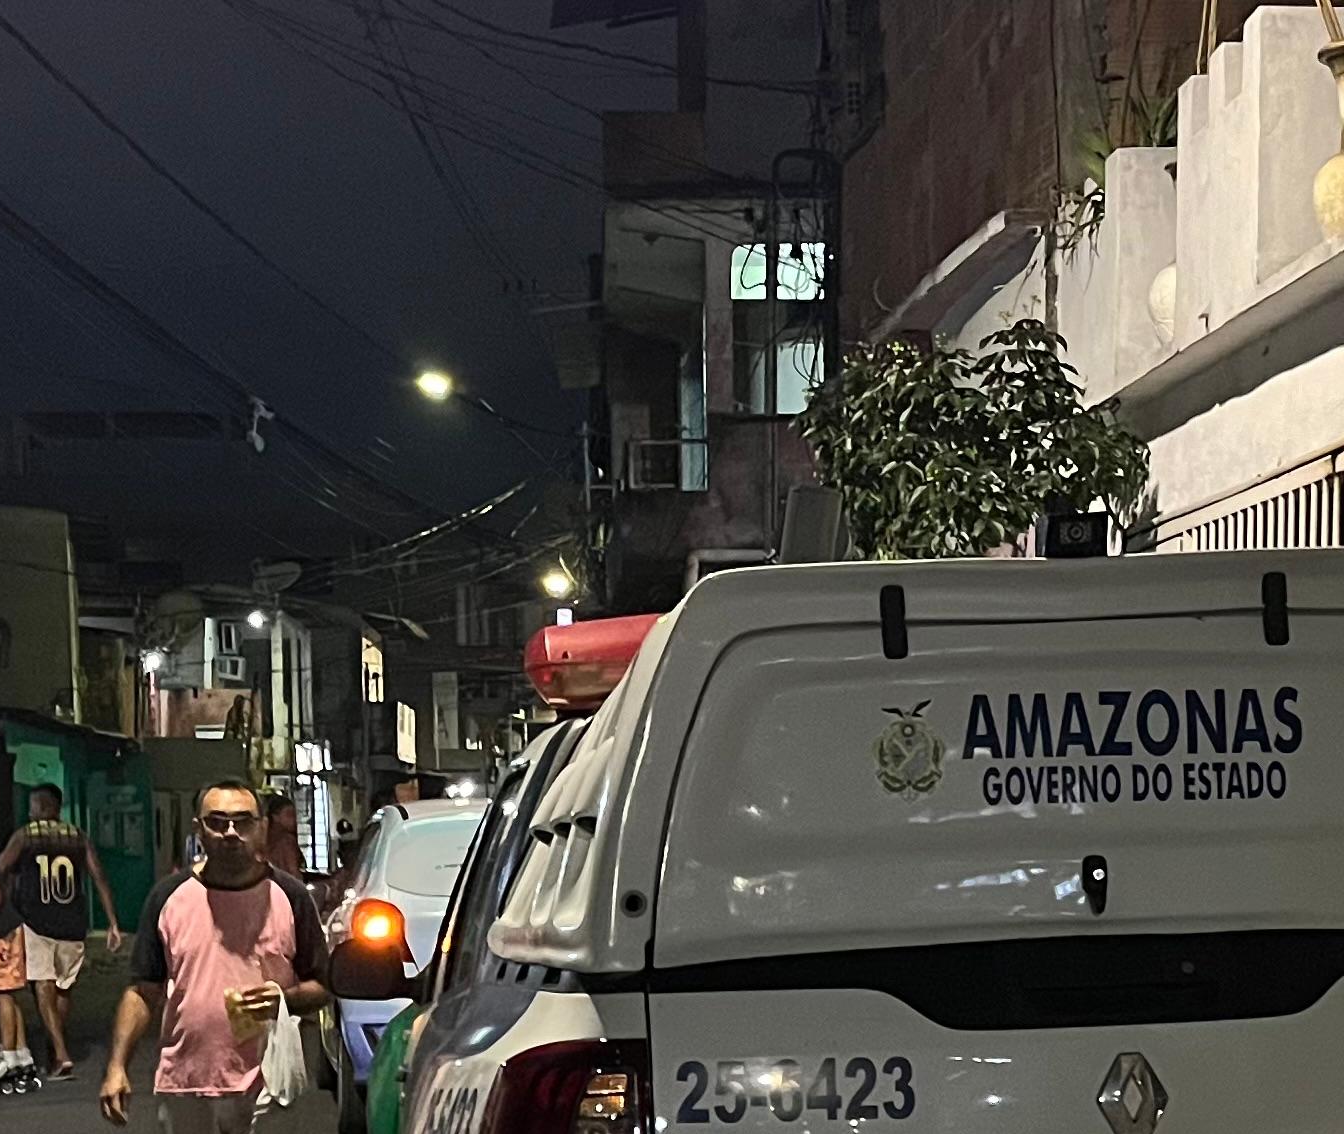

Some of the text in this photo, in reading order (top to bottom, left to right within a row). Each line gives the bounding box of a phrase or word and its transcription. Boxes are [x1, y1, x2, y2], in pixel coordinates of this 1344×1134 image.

[962, 686, 1303, 760] AMAZONAS
[982, 760, 1287, 806] GOVERNO DO ESTADO
[35, 854, 75, 905] 10
[675, 1055, 916, 1124] 25-6423
